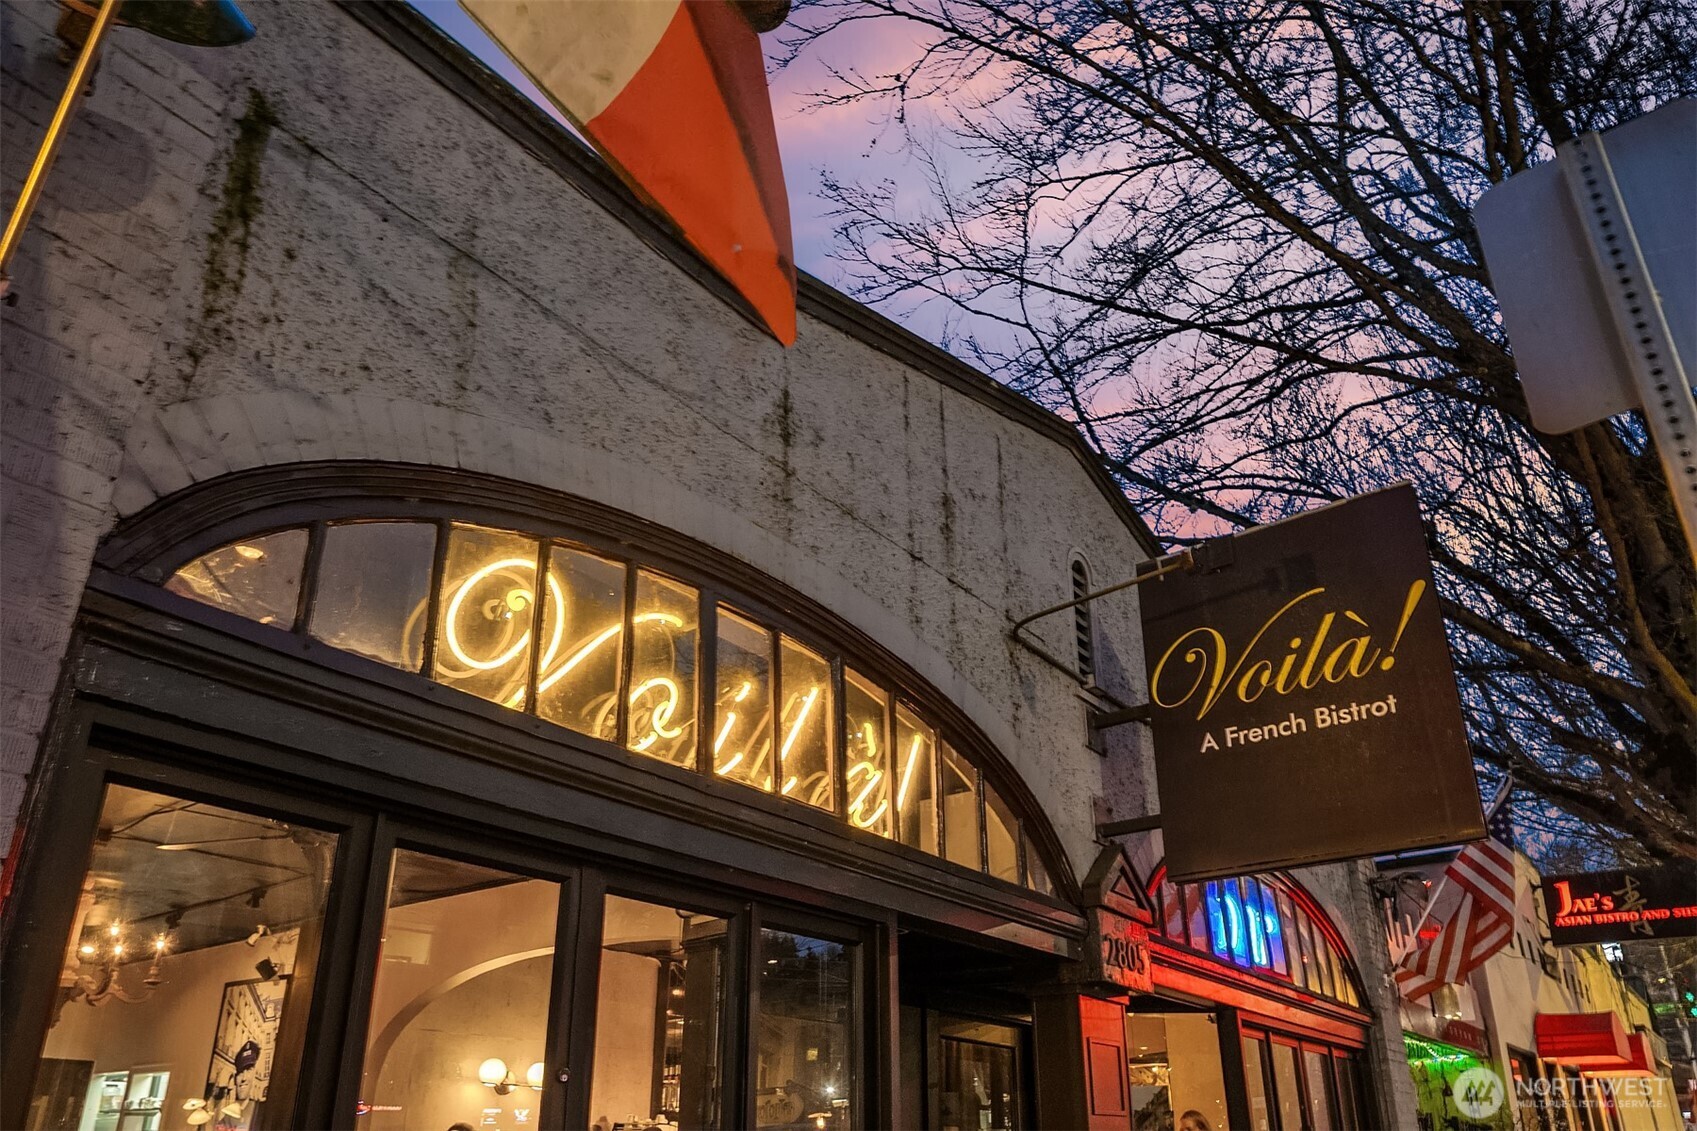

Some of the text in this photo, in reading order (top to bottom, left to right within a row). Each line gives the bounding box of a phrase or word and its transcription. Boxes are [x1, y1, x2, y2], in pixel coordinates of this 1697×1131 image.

[1151, 579, 1426, 720] Voilà!
[1200, 694, 1397, 753] A French Bistrot
[1555, 914, 1592, 927] ASIAN
[1593, 911, 1639, 925] BISTRO
[1641, 908, 1671, 921] AND
[1104, 933, 1145, 976] 2805
